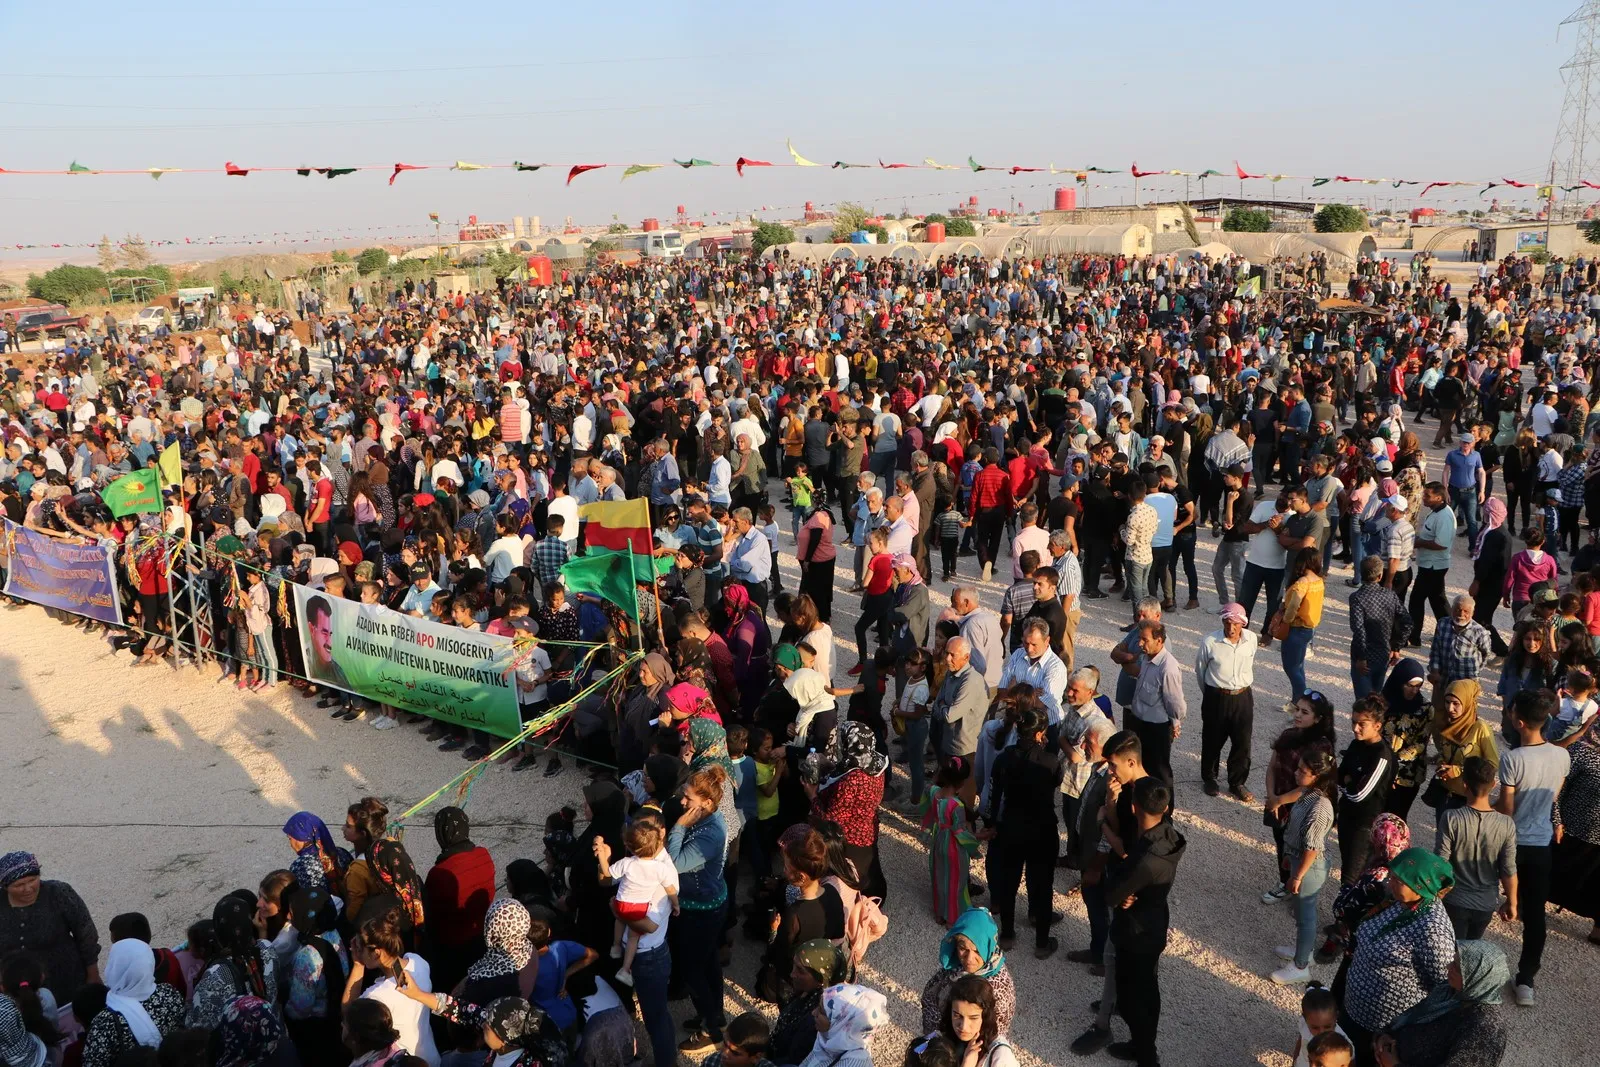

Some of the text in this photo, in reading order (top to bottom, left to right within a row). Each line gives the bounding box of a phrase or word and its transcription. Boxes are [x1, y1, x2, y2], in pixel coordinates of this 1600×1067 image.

[416, 632, 435, 649] APO
[393, 648, 431, 671] NETEWA
[420, 681, 447, 697] القائد
[450, 688, 474, 705] حرية
[460, 708, 485, 726] لبناء
